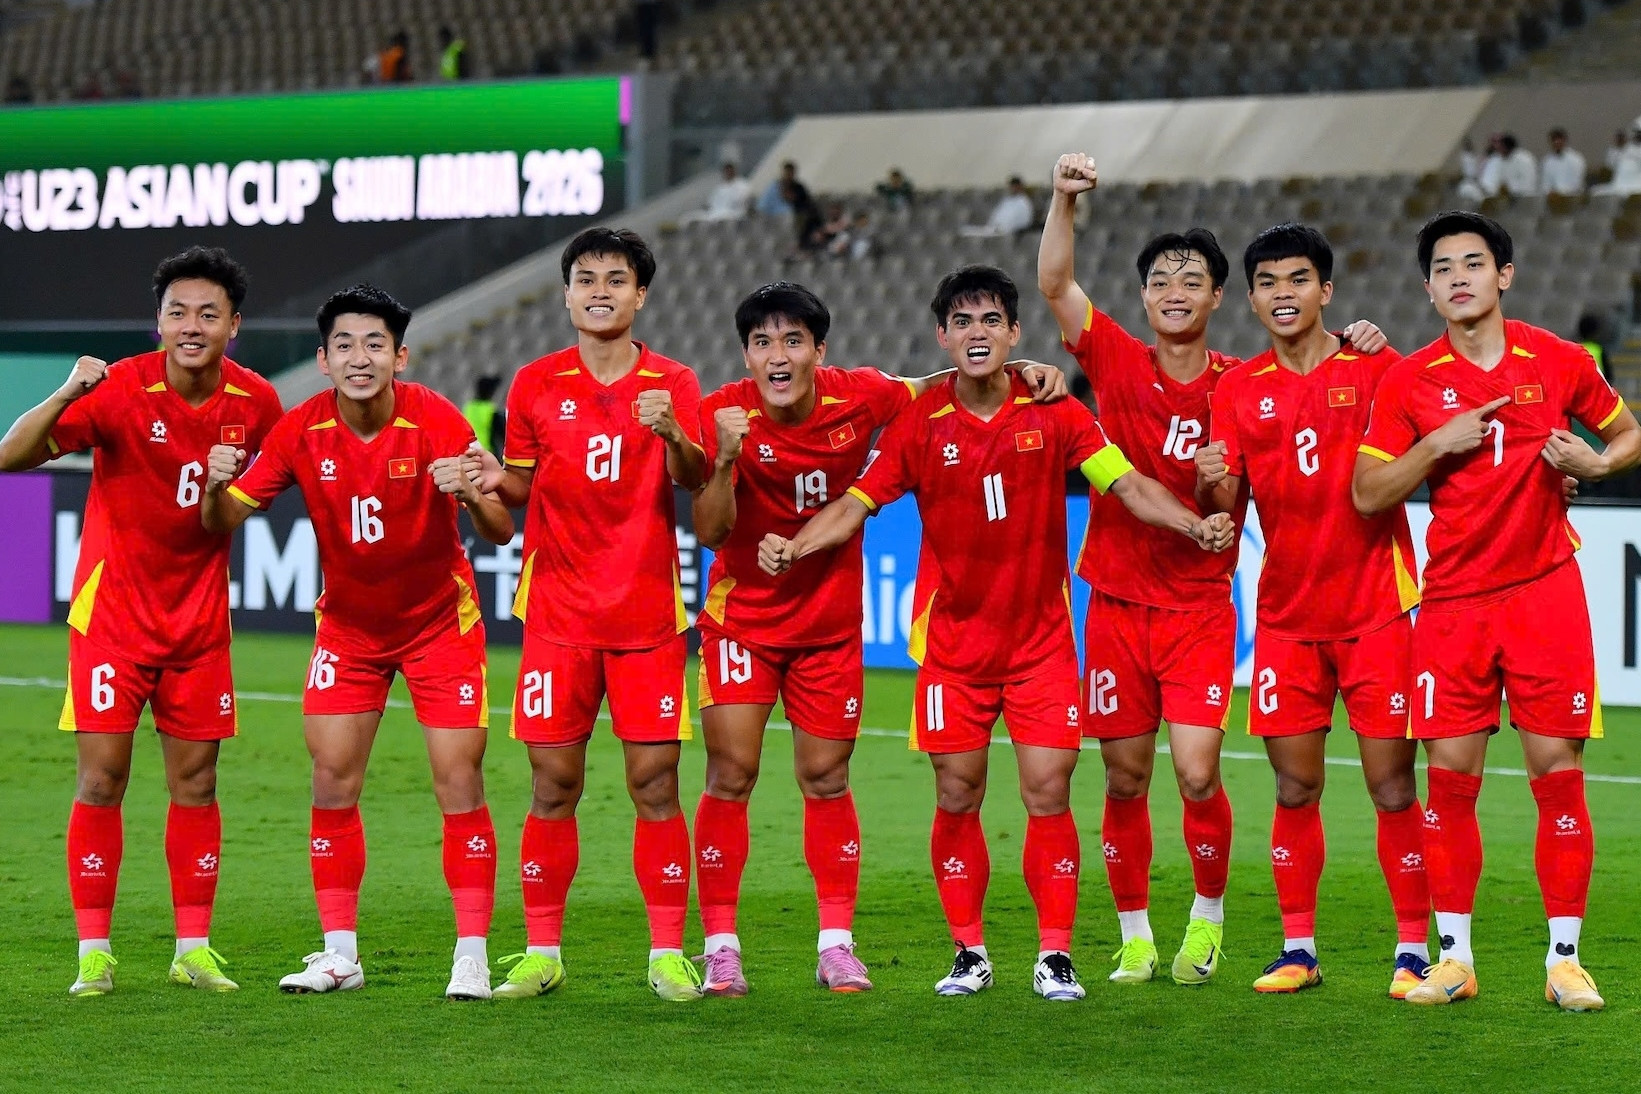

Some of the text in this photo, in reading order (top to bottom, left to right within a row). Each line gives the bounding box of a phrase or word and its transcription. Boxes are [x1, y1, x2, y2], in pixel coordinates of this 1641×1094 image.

[21, 167, 99, 232] U23
[98, 163, 229, 229] ASIAN
[228, 159, 321, 226] CUP
[585, 433, 623, 483] 21
[1162, 415, 1203, 461] 12
[1295, 427, 1320, 477] 2
[1484, 418, 1505, 467] 7
[176, 460, 204, 508] 6
[794, 469, 828, 514] 19
[982, 472, 1007, 522] 11
[351, 495, 385, 544] 16
[307, 646, 340, 691] 16
[719, 638, 752, 685] 19
[91, 662, 116, 713] 6
[522, 669, 553, 719] 21
[926, 683, 945, 732] 11
[1089, 668, 1118, 716] 12
[1258, 666, 1279, 715] 2
[1417, 670, 1435, 720] 7
